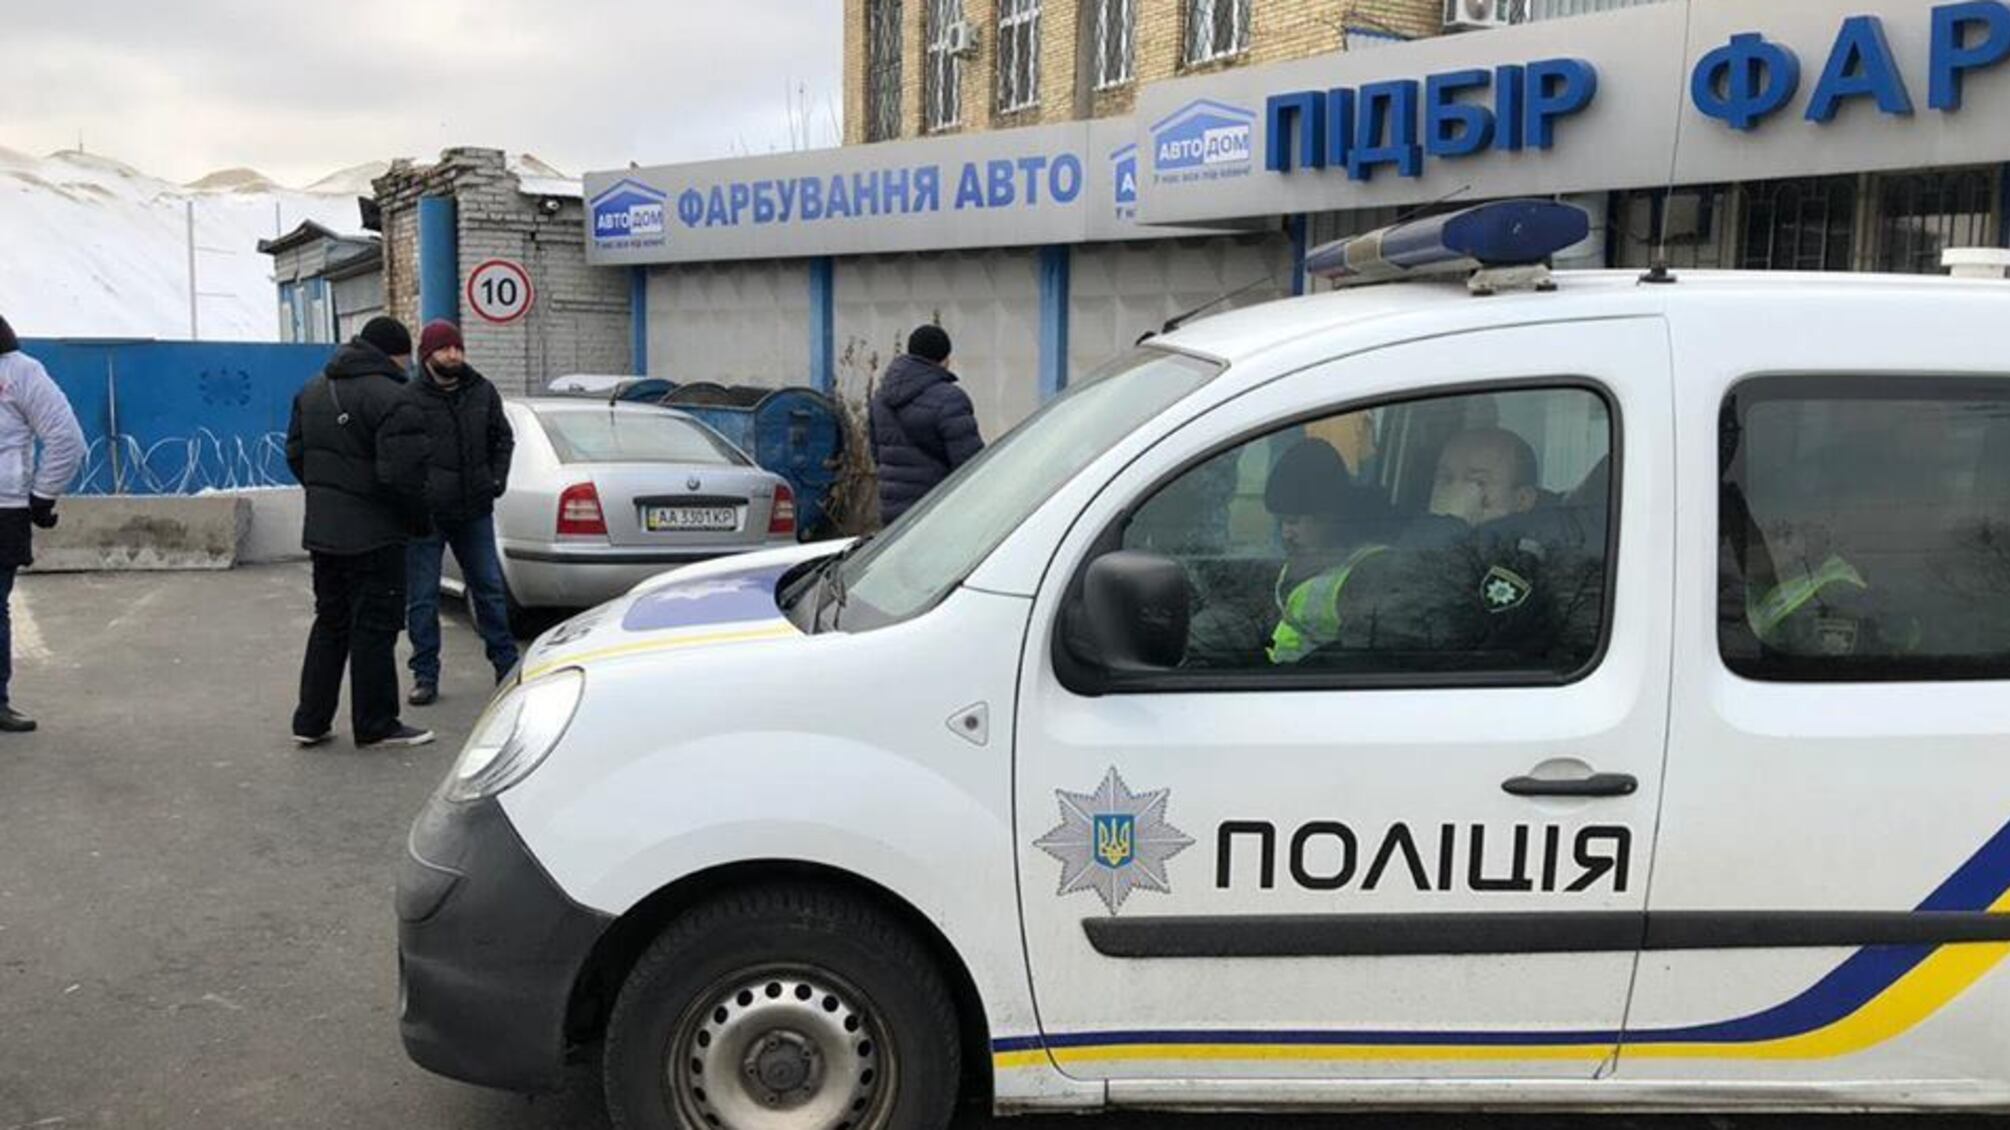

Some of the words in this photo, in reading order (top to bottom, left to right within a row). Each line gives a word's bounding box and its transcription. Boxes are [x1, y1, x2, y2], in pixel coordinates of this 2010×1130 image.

[1265, 56, 1598, 182] ПІДБІР
[1691, 0, 2010, 131] ФАР
[677, 164, 940, 228] ФАРБУВАННЯ
[953, 152, 1083, 210] АВТО
[481, 277, 517, 306] 10
[1216, 820, 1632, 893] ПОЛІЦІЯ
